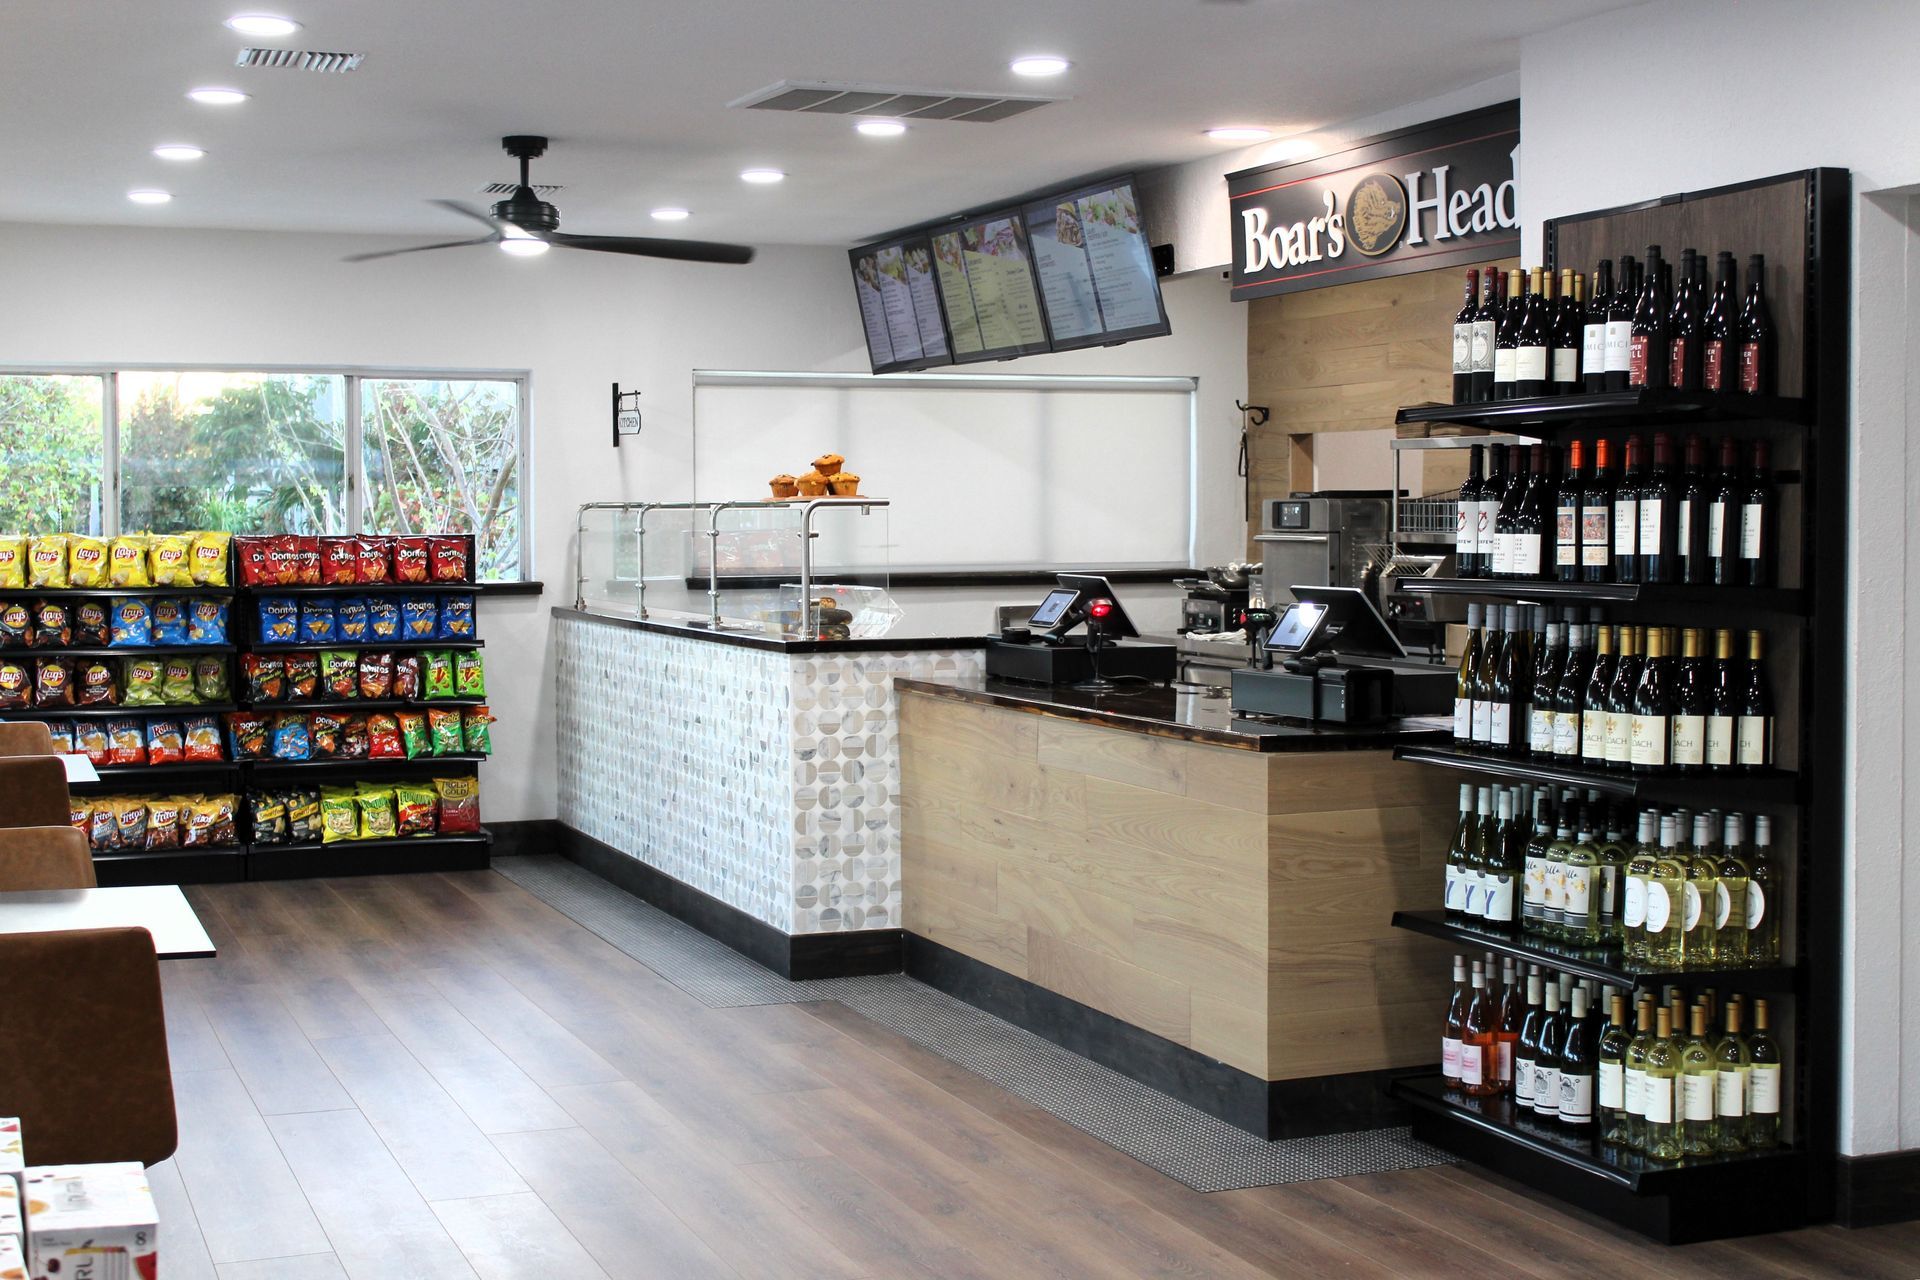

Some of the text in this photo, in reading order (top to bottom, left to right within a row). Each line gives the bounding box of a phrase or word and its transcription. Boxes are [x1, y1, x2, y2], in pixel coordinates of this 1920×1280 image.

[1241, 144, 1521, 274] Boar's Head
[271, 552, 299, 561] Doritos
[299, 551, 320, 561] oritos
[438, 550, 466, 561] Doritos
[267, 606, 297, 615] Doritos
[406, 602, 435, 611] Doritos
[329, 660, 356, 669] Doritos
[445, 788, 468, 796] GOLD
[136, 1231, 147, 1246] 8
